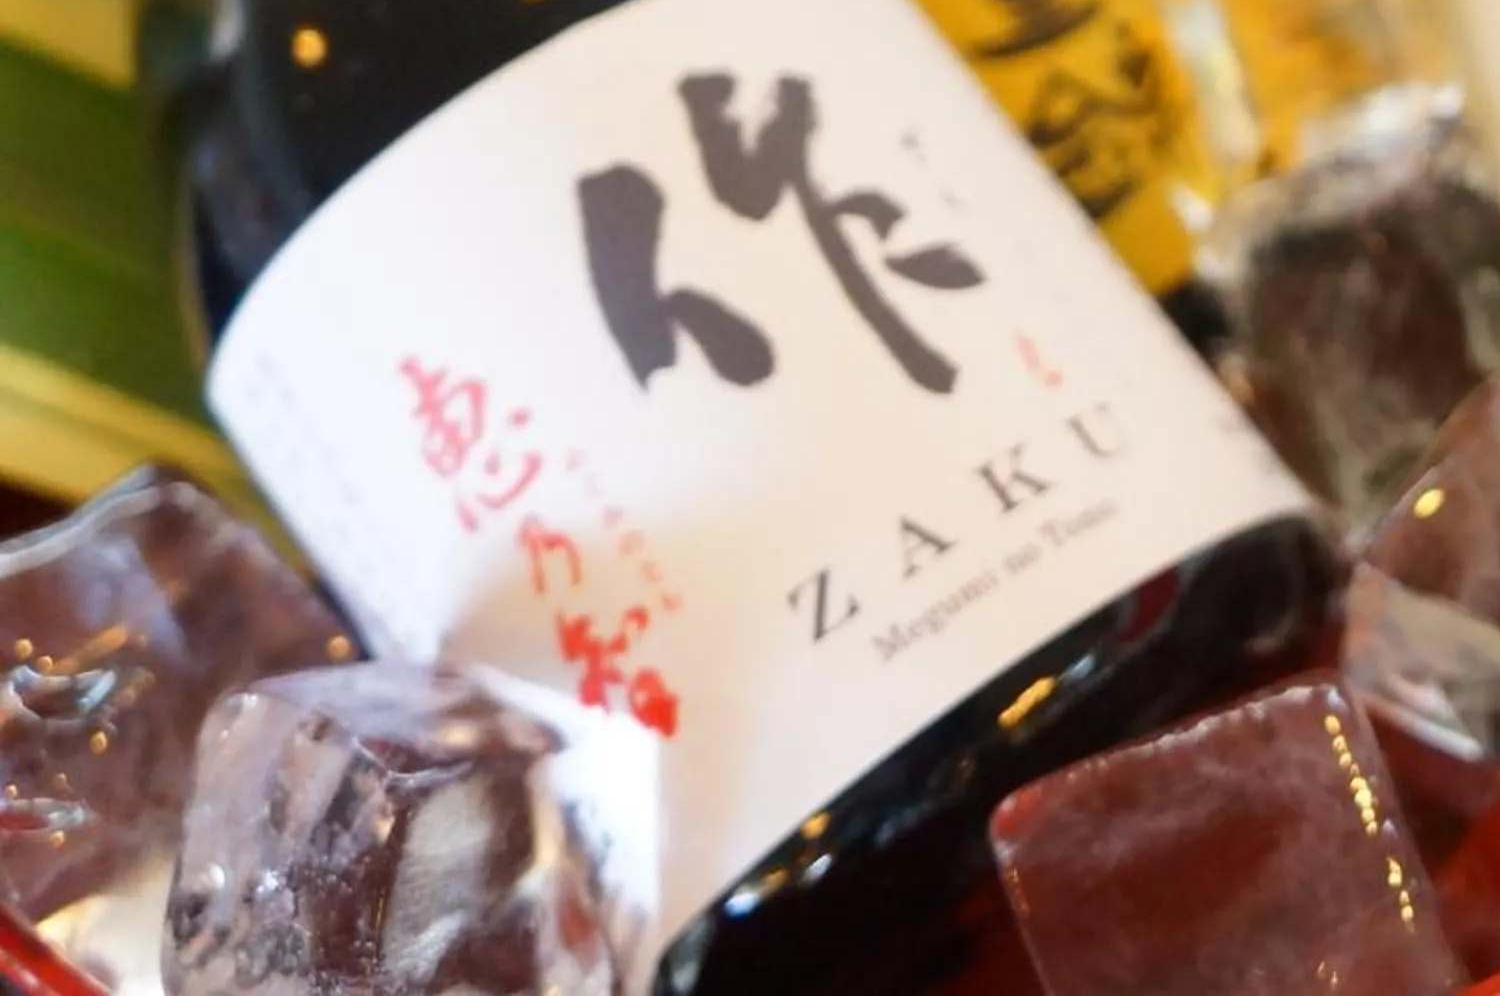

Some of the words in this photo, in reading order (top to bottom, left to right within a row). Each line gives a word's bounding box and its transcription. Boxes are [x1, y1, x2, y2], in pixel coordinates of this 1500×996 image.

[577, 71, 984, 393] 作
[788, 402, 1126, 642] ZAKU
[874, 571, 998, 663] Megumi
